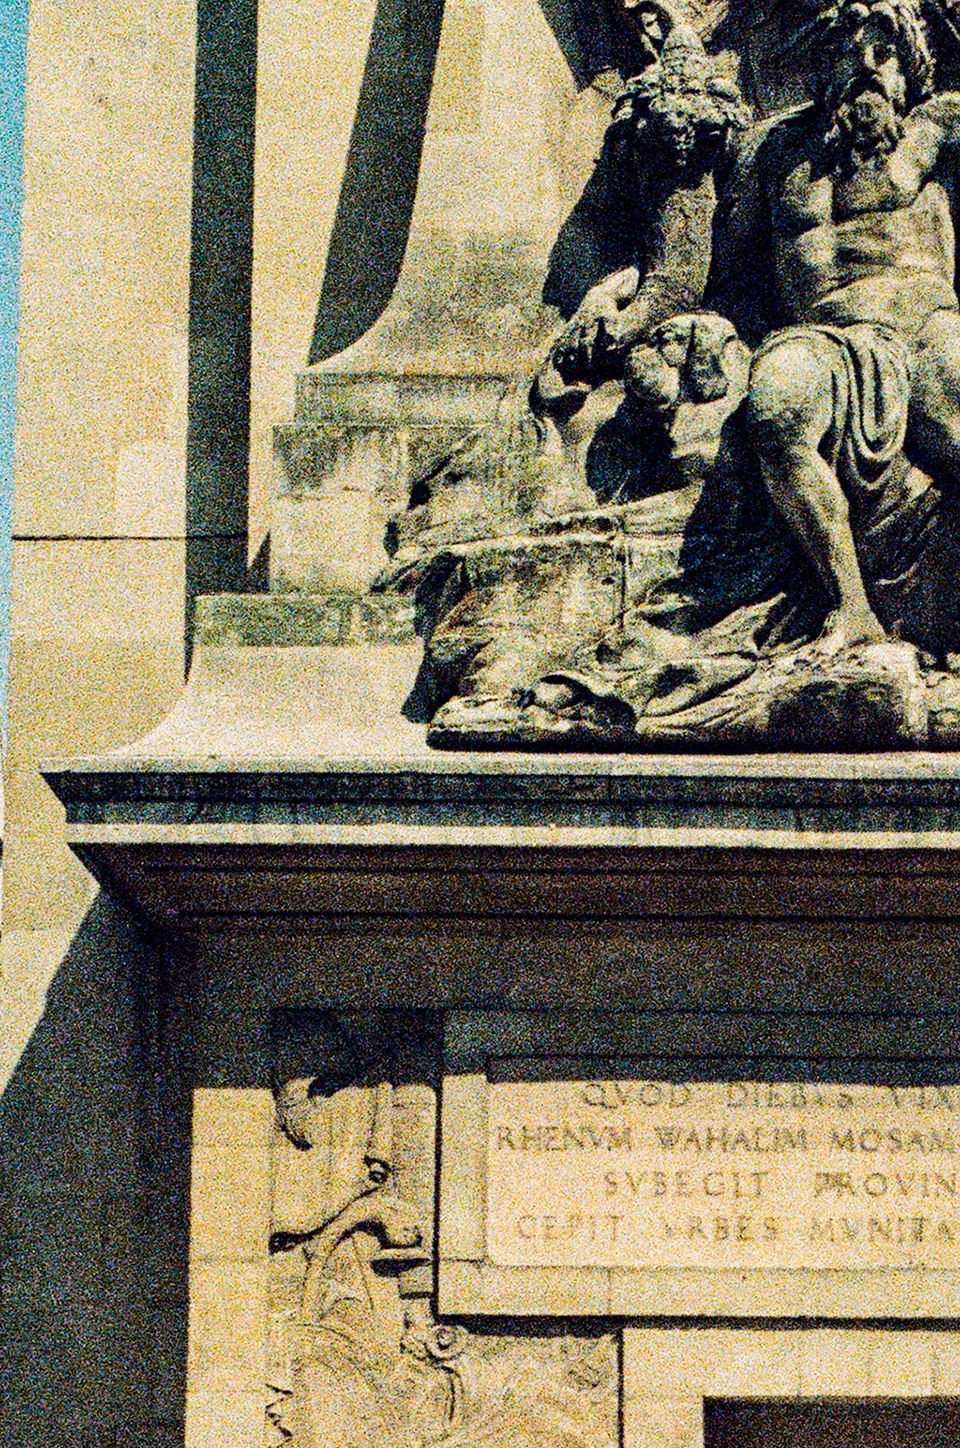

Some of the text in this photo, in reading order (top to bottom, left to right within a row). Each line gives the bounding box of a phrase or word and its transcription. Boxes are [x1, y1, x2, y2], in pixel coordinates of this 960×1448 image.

[580, 1083, 693, 1110] QVOD
[496, 1125, 633, 1153] RHENVM
[653, 1125, 809, 1154] WAHALIM
[829, 1125, 956, 1155] MOSAM
[603, 1169, 769, 1199] SVBEGIT
[515, 1213, 624, 1243] CEPIT
